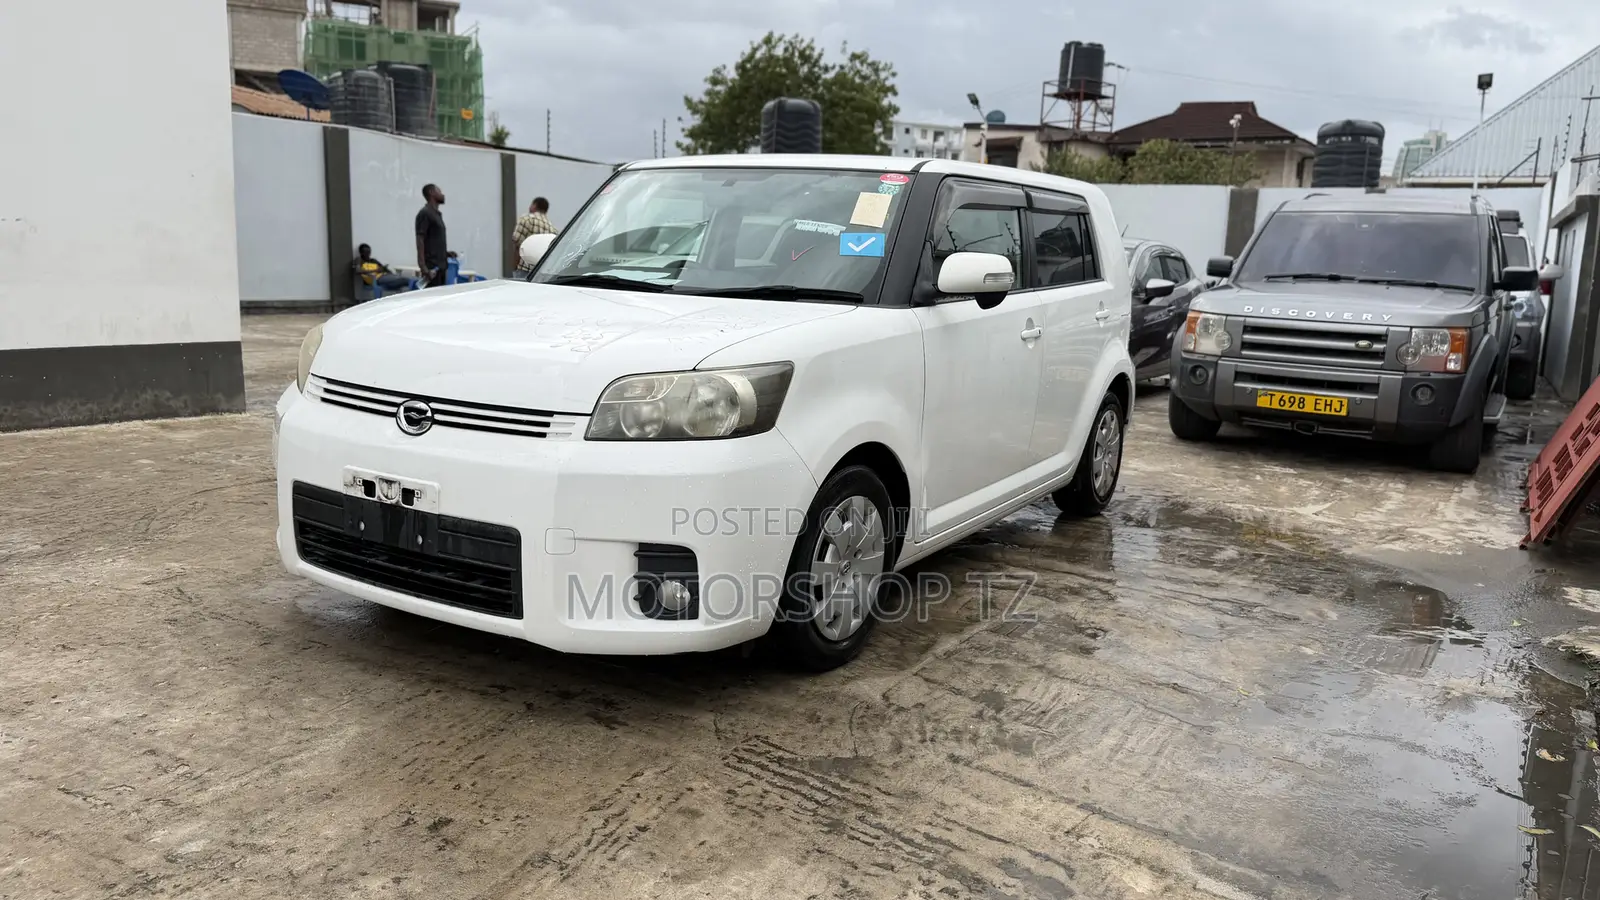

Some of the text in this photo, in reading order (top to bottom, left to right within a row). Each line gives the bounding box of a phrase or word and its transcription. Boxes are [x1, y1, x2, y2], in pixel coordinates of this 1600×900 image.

[1243, 305, 1393, 322] DISCOVERY
[1267, 393, 1344, 414] T 698 EHJ
